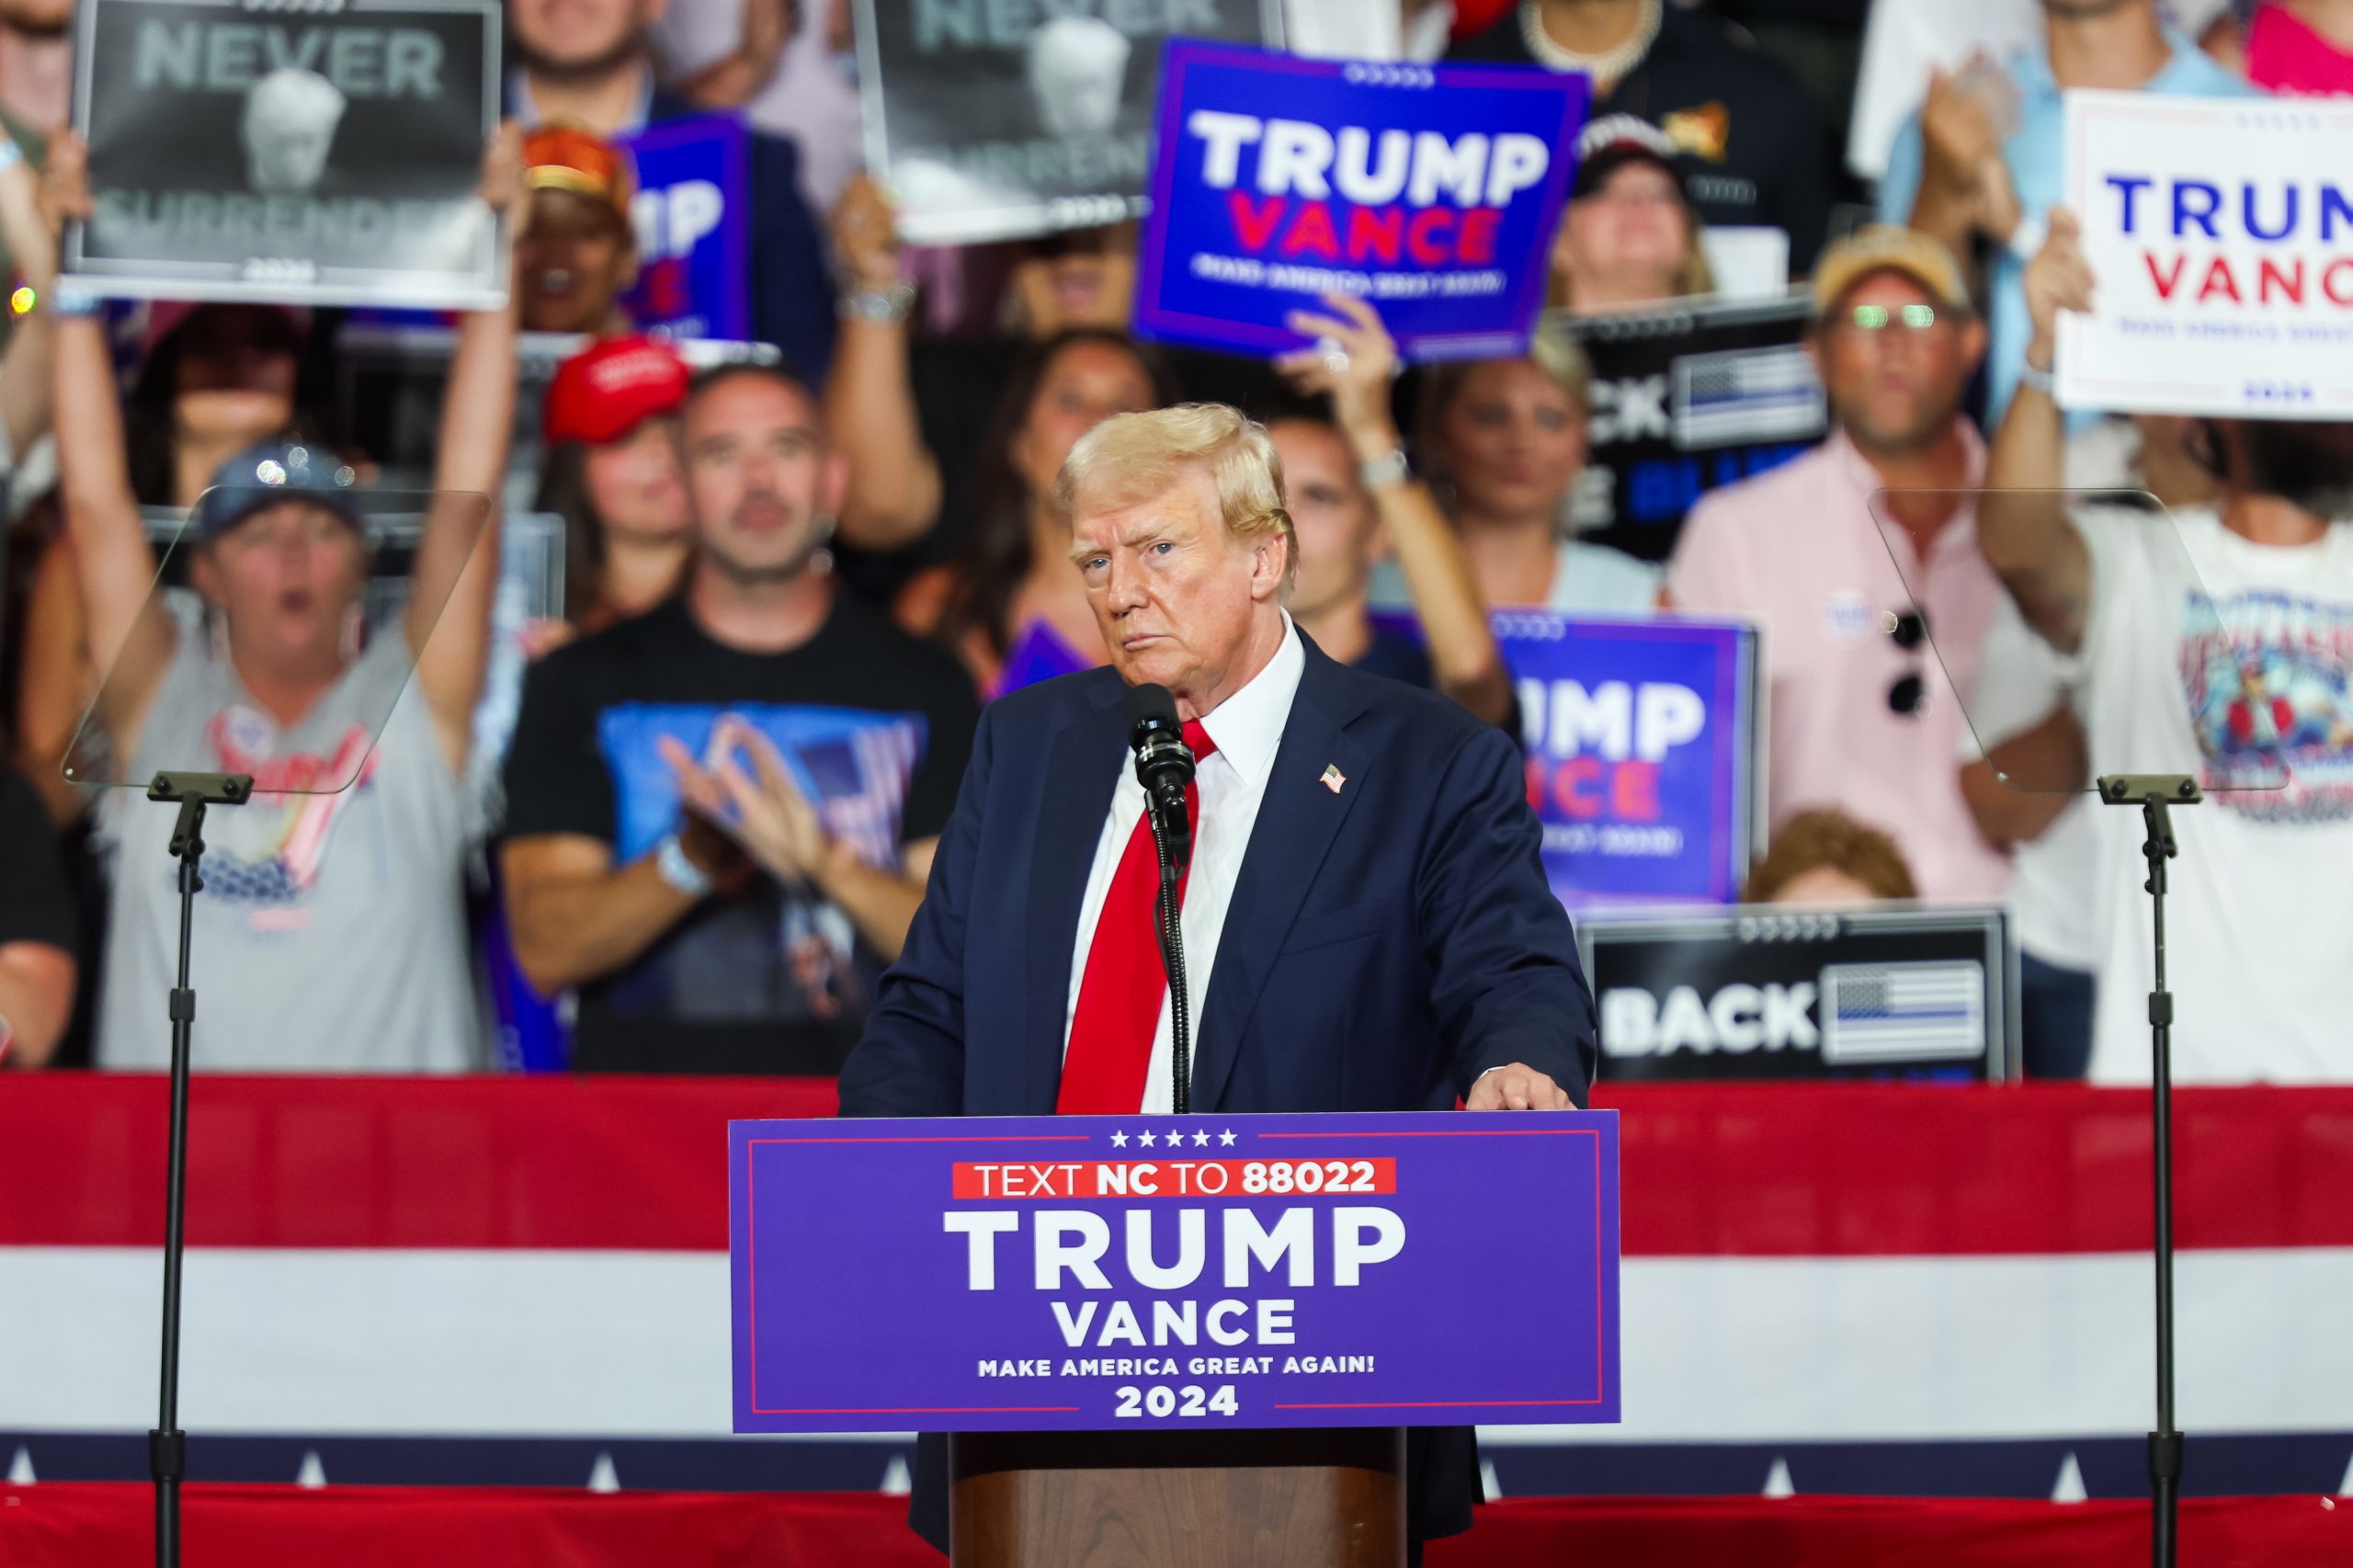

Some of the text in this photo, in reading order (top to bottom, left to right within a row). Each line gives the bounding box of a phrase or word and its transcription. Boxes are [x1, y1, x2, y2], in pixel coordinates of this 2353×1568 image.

[135, 18, 447, 99] NEVER
[1188, 108, 1551, 209] TRUMP
[1226, 188, 1505, 265] VANCE
[2103, 175, 2353, 241] TRUM
[2142, 248, 2353, 309] VANC
[1586, 372, 1667, 448] CK
[1598, 981, 1821, 1058] BACK
[972, 1159, 1377, 1197] TEXT NC TO 88022
[943, 1205, 1406, 1291] TRUMP
[1050, 1298, 1297, 1348] VANCE
[977, 1355, 1376, 1378] MAKE AMERICA GREAT AGAIN!
[1114, 1384, 1240, 1418] 2024
